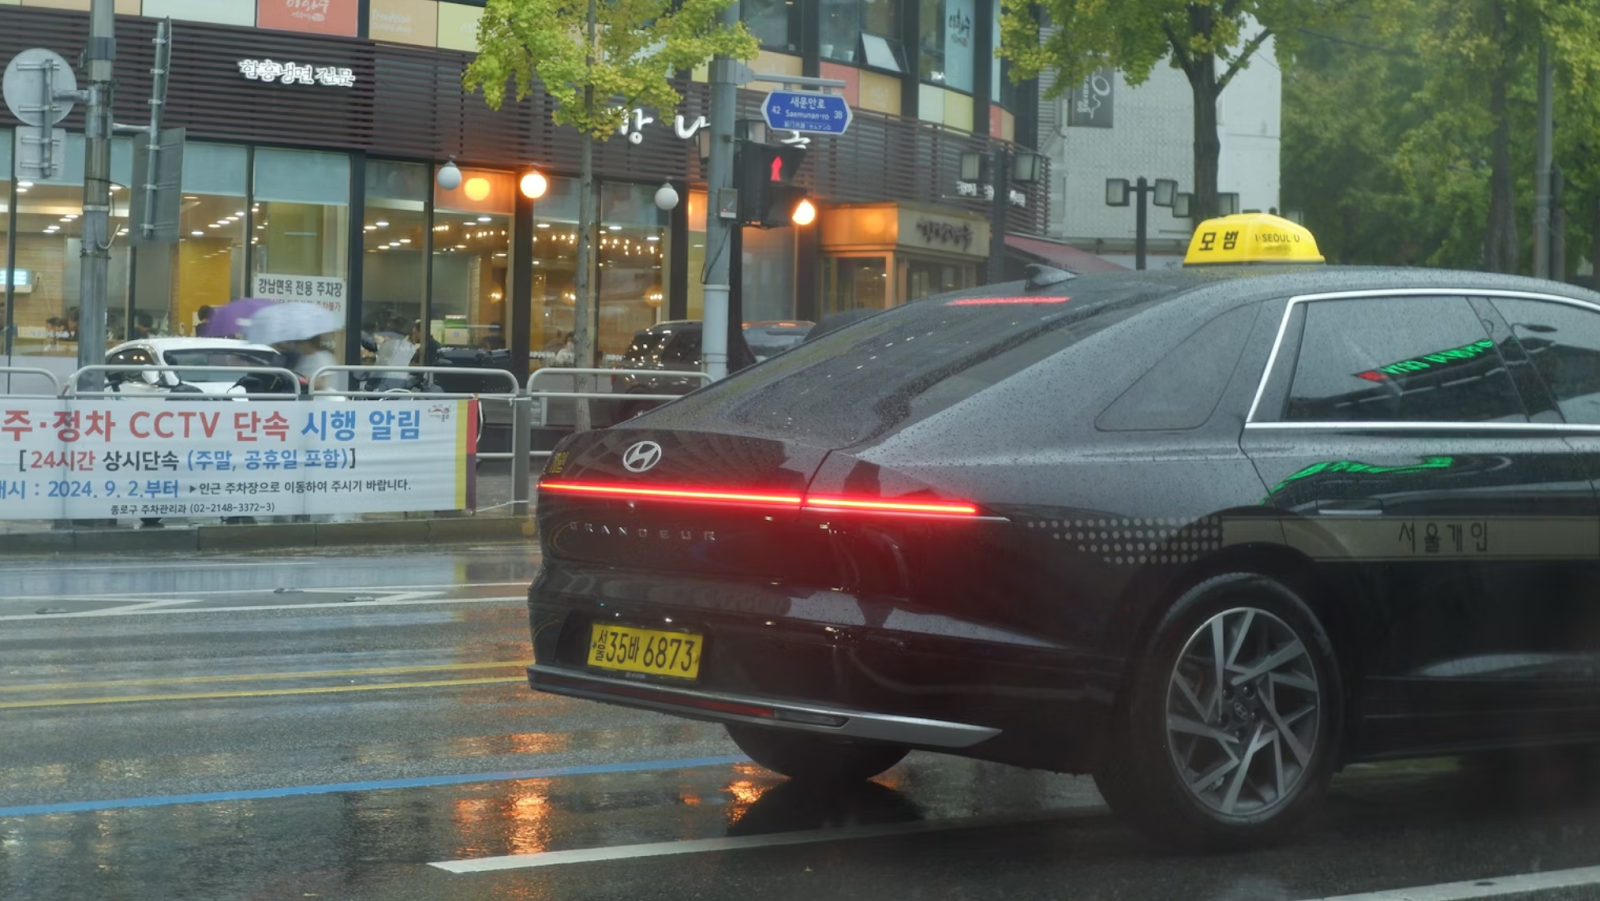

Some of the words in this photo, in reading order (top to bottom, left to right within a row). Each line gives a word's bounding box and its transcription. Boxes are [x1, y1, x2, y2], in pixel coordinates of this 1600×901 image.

[238, 59, 314, 85] 함흥냉면
[314, 66, 356, 87] 전문
[771, 105, 781, 115] 42
[790, 97, 826, 109] 새문안로
[785, 109, 830, 121] Saemunan-ro
[834, 110, 843, 120] 38
[258, 279, 293, 295] 강남면옥
[295, 280, 313, 296] 전용
[316, 281, 343, 298] 주차장
[1, 410, 116, 442] 주·정차
[129, 411, 221, 438] CCTV
[233, 410, 290, 442] 단속
[301, 409, 356, 441] 시행
[369, 409, 421, 440] 알림
[102, 450, 180, 471] 상시단속
[187, 449, 236, 472] (주말,
[244, 449, 298, 470] 공휴일
[304, 448, 356, 469] 포함)]
[47, 480, 98, 499] 2024.
[104, 480, 121, 498] 9.
[199, 482, 221, 496] 인근
[225, 481, 281, 494] 주차장으로
[284, 480, 327, 493] 이동하여
[330, 479, 362, 492] 주시기
[366, 478, 412, 492] 바랍니다.
[110, 504, 138, 515] 종로구
[141, 503, 187, 515] 주차관리과
[190, 501, 276, 514] (02-2148-3372~3)
[569, 521, 716, 541] GRANDEUR
[1399, 522, 1488, 553] 서울개인
[595, 630, 608, 662] 서울
[606, 632, 640, 664] 35바
[643, 636, 695, 672] 6873
